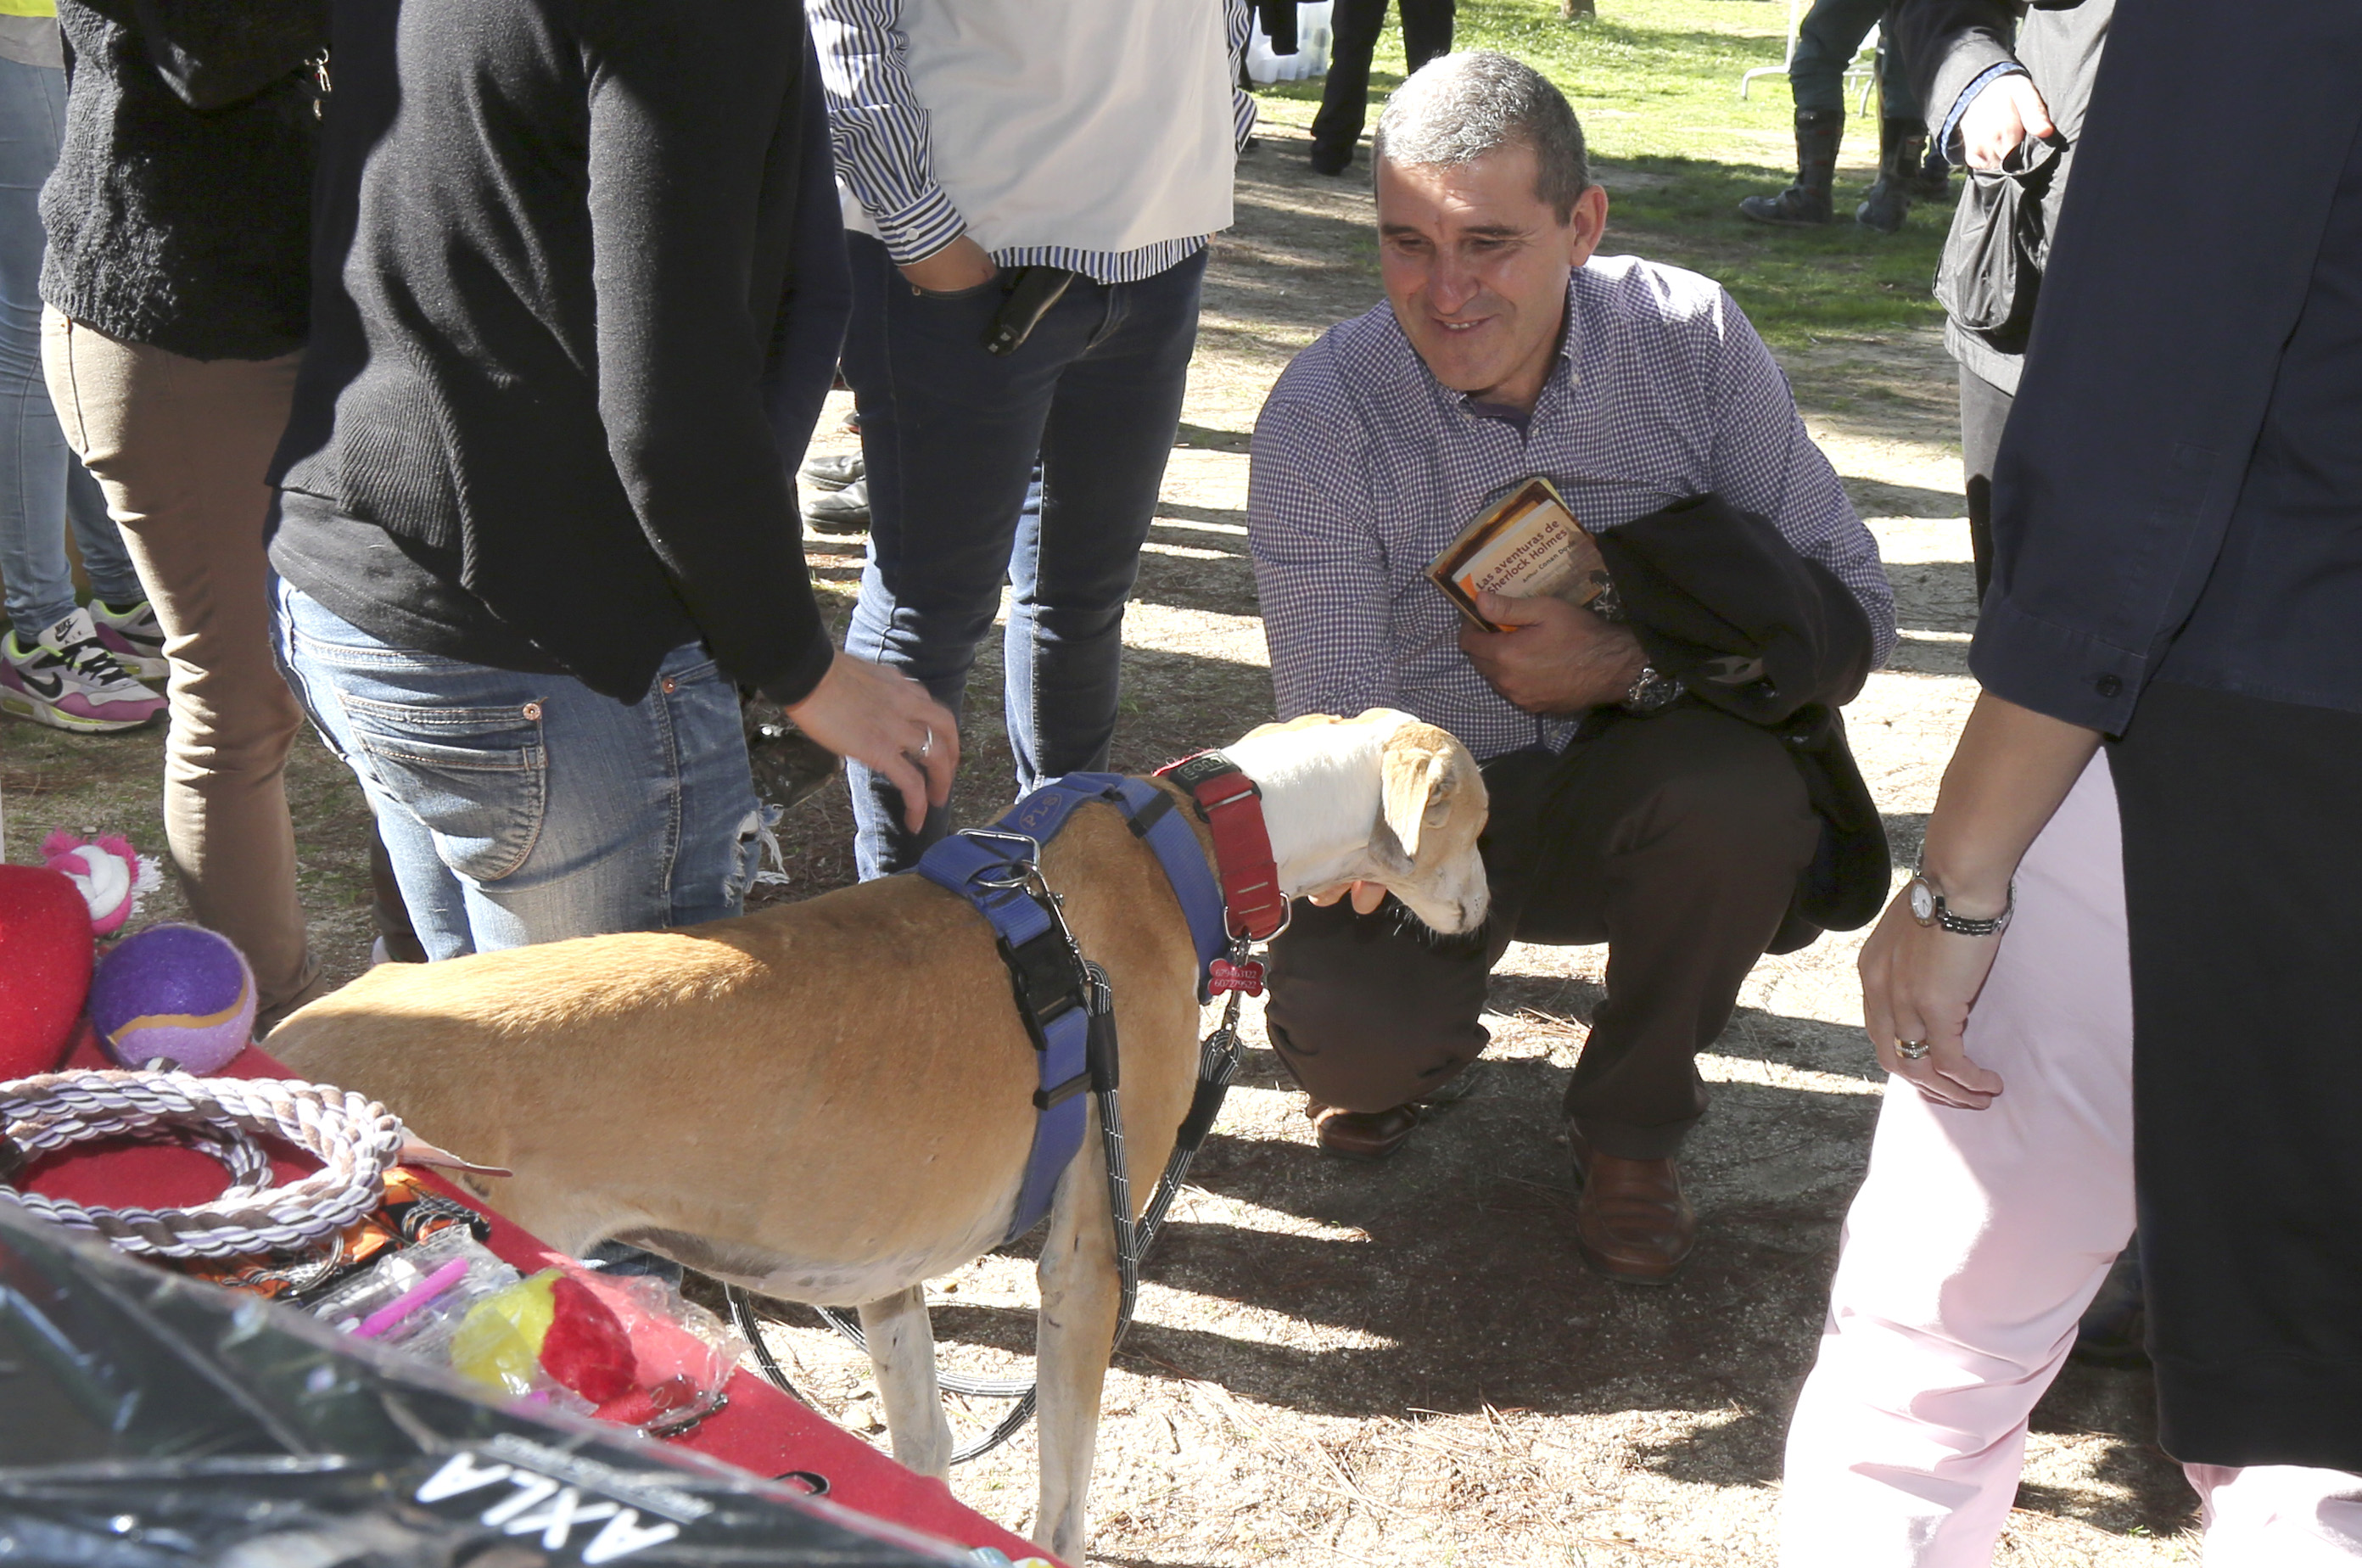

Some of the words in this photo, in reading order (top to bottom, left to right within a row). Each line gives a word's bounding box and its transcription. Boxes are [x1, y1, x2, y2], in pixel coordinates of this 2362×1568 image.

[1476, 572, 1494, 591] Las
[1494, 532, 1544, 574] aventuras
[1545, 520, 1559, 534] de
[1487, 557, 1531, 595] Sherlock
[1530, 529, 1568, 560] Holmes
[1538, 553, 1559, 569] Conan
[54, 618, 71, 633] NIKE
[415, 1450, 680, 1565] AXLA
